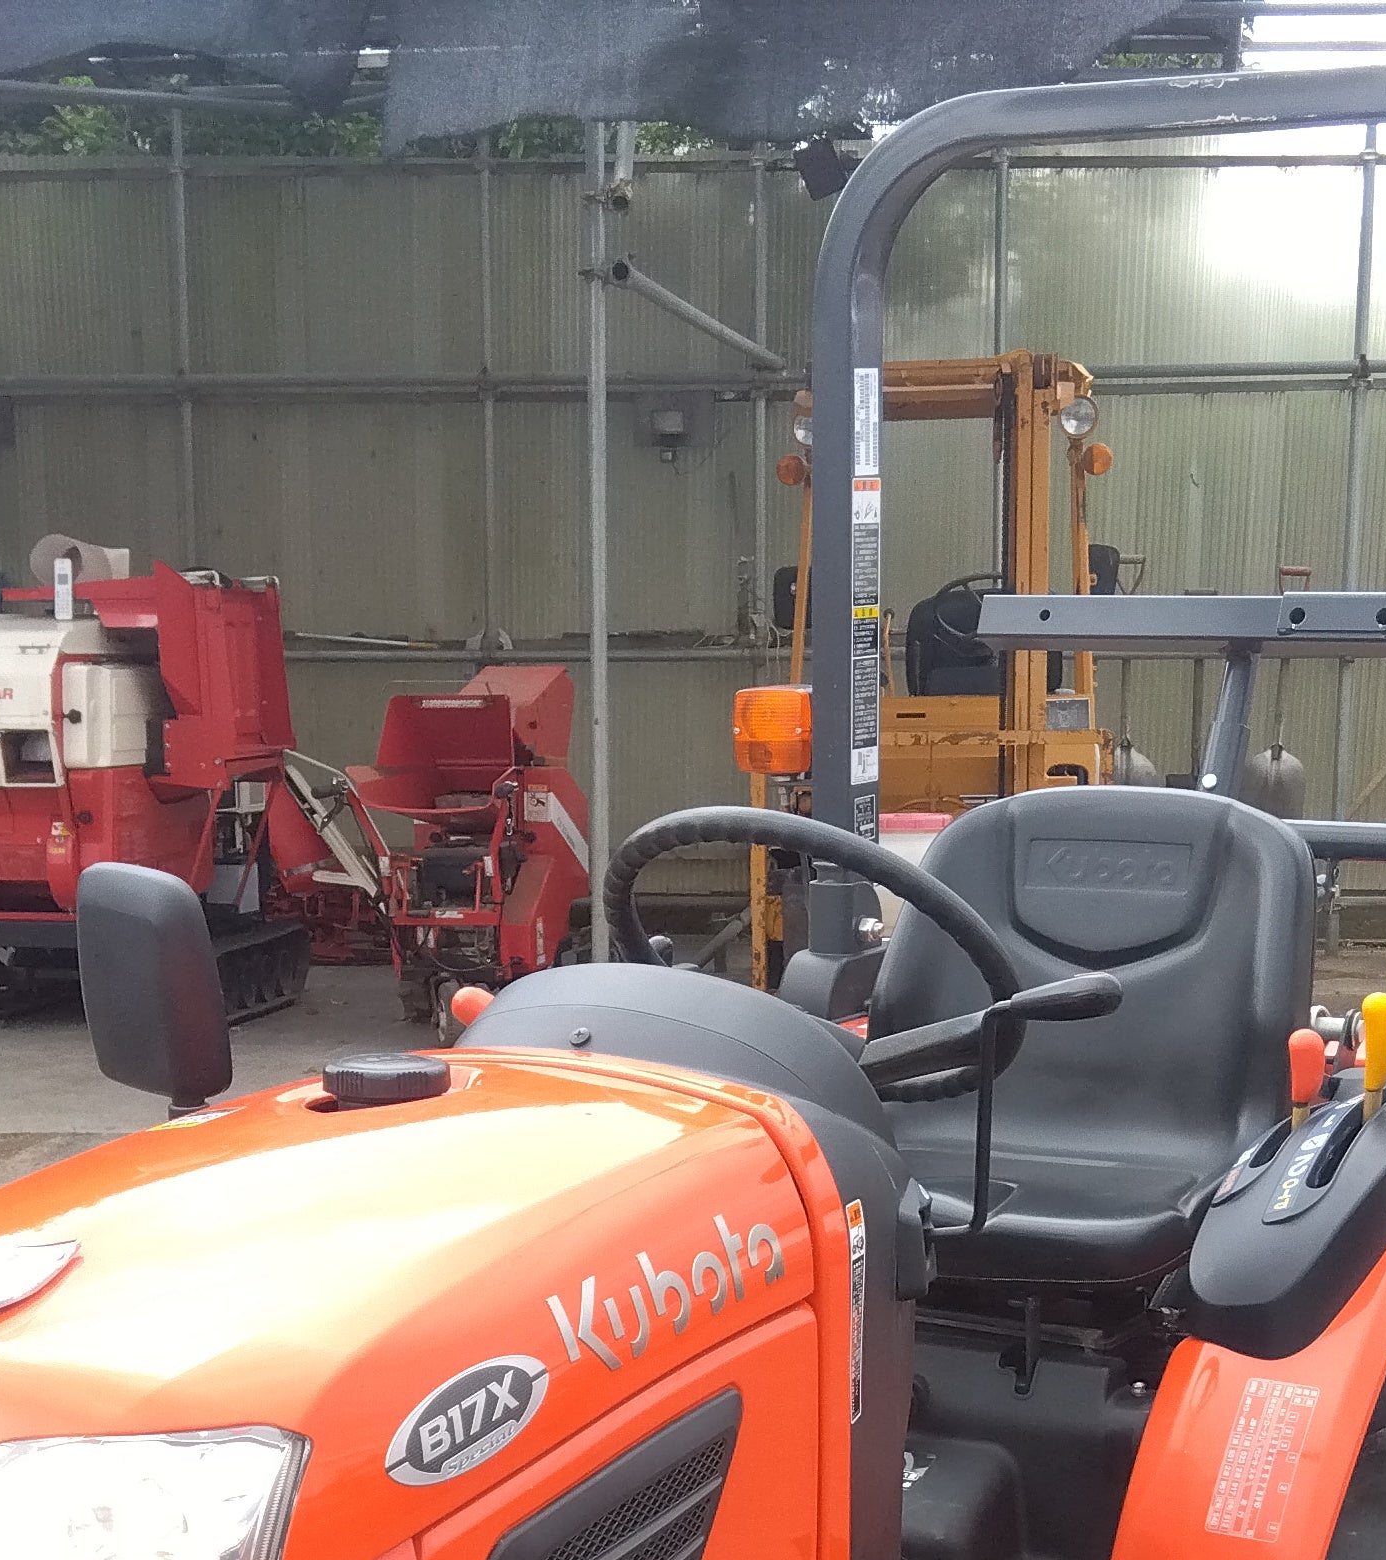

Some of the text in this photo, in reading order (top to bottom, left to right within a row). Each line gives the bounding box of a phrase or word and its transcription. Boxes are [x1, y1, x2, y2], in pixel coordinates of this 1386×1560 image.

[545, 1213, 785, 1371] Kubota
[419, 1369, 520, 1464] B17X
[446, 1426, 513, 1476] Special
